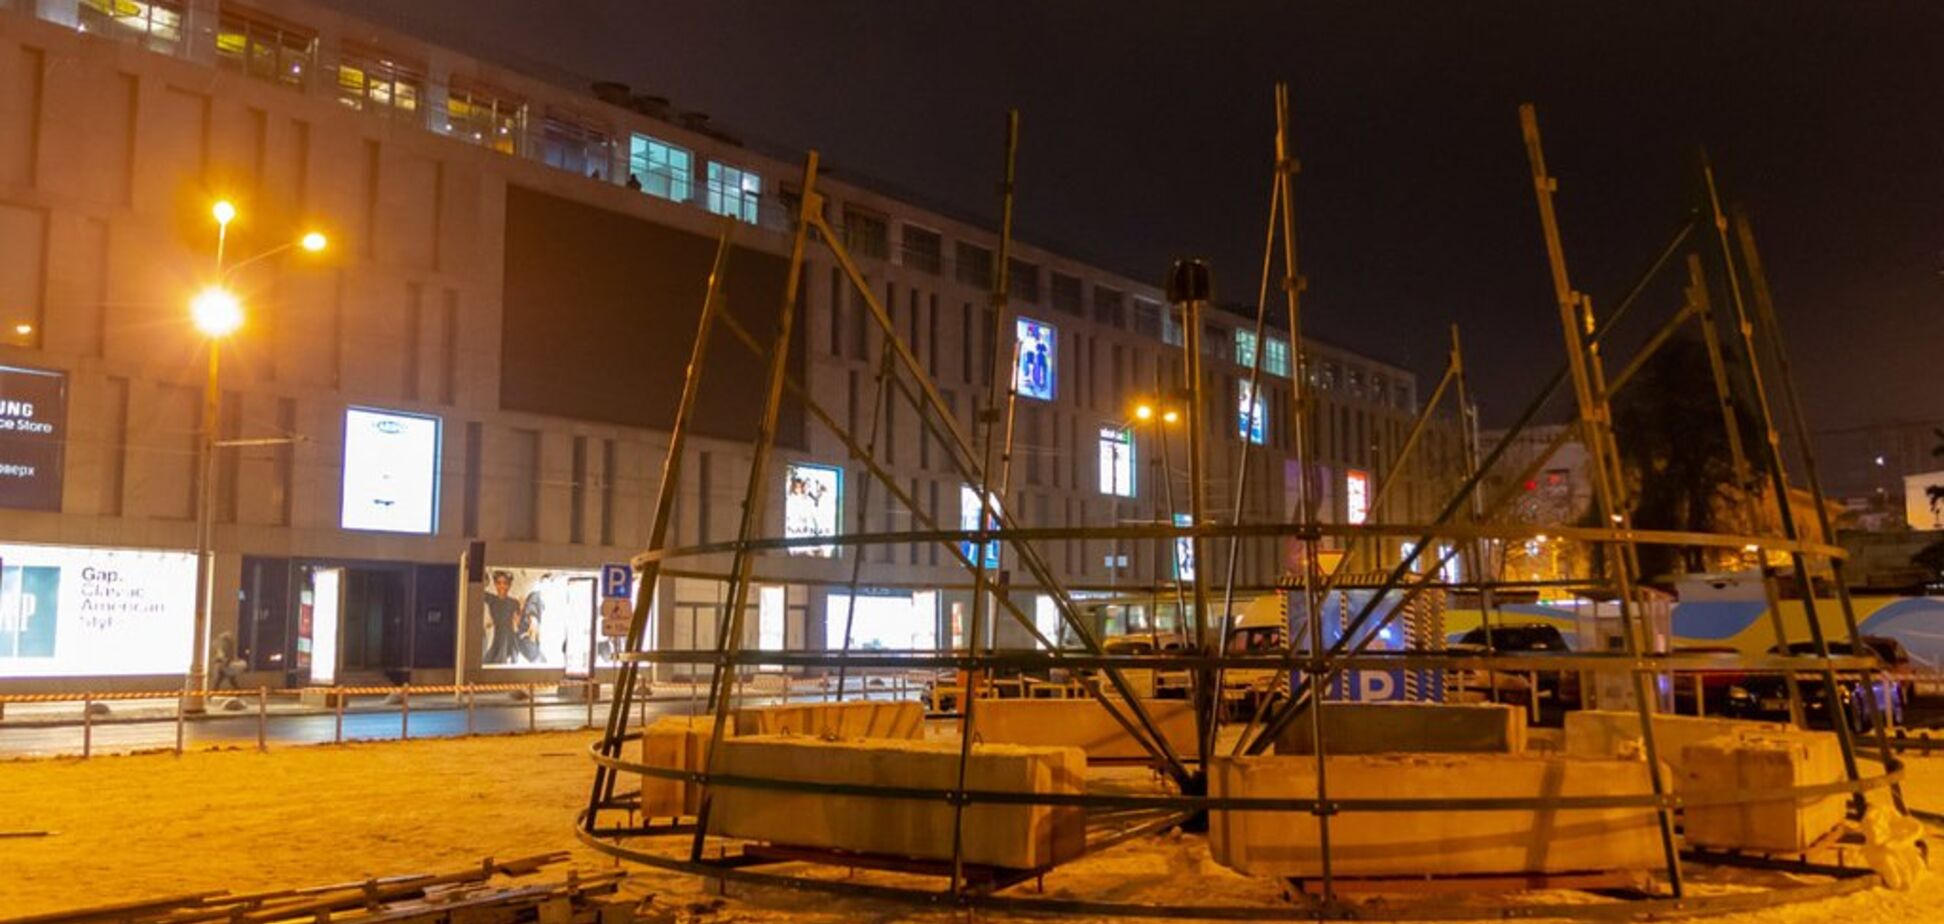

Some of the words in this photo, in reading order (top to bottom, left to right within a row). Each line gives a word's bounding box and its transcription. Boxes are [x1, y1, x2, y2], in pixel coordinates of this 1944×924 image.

[17, 419, 53, 434] Store
[608, 567, 626, 595] P
[1360, 669, 1395, 702] P
